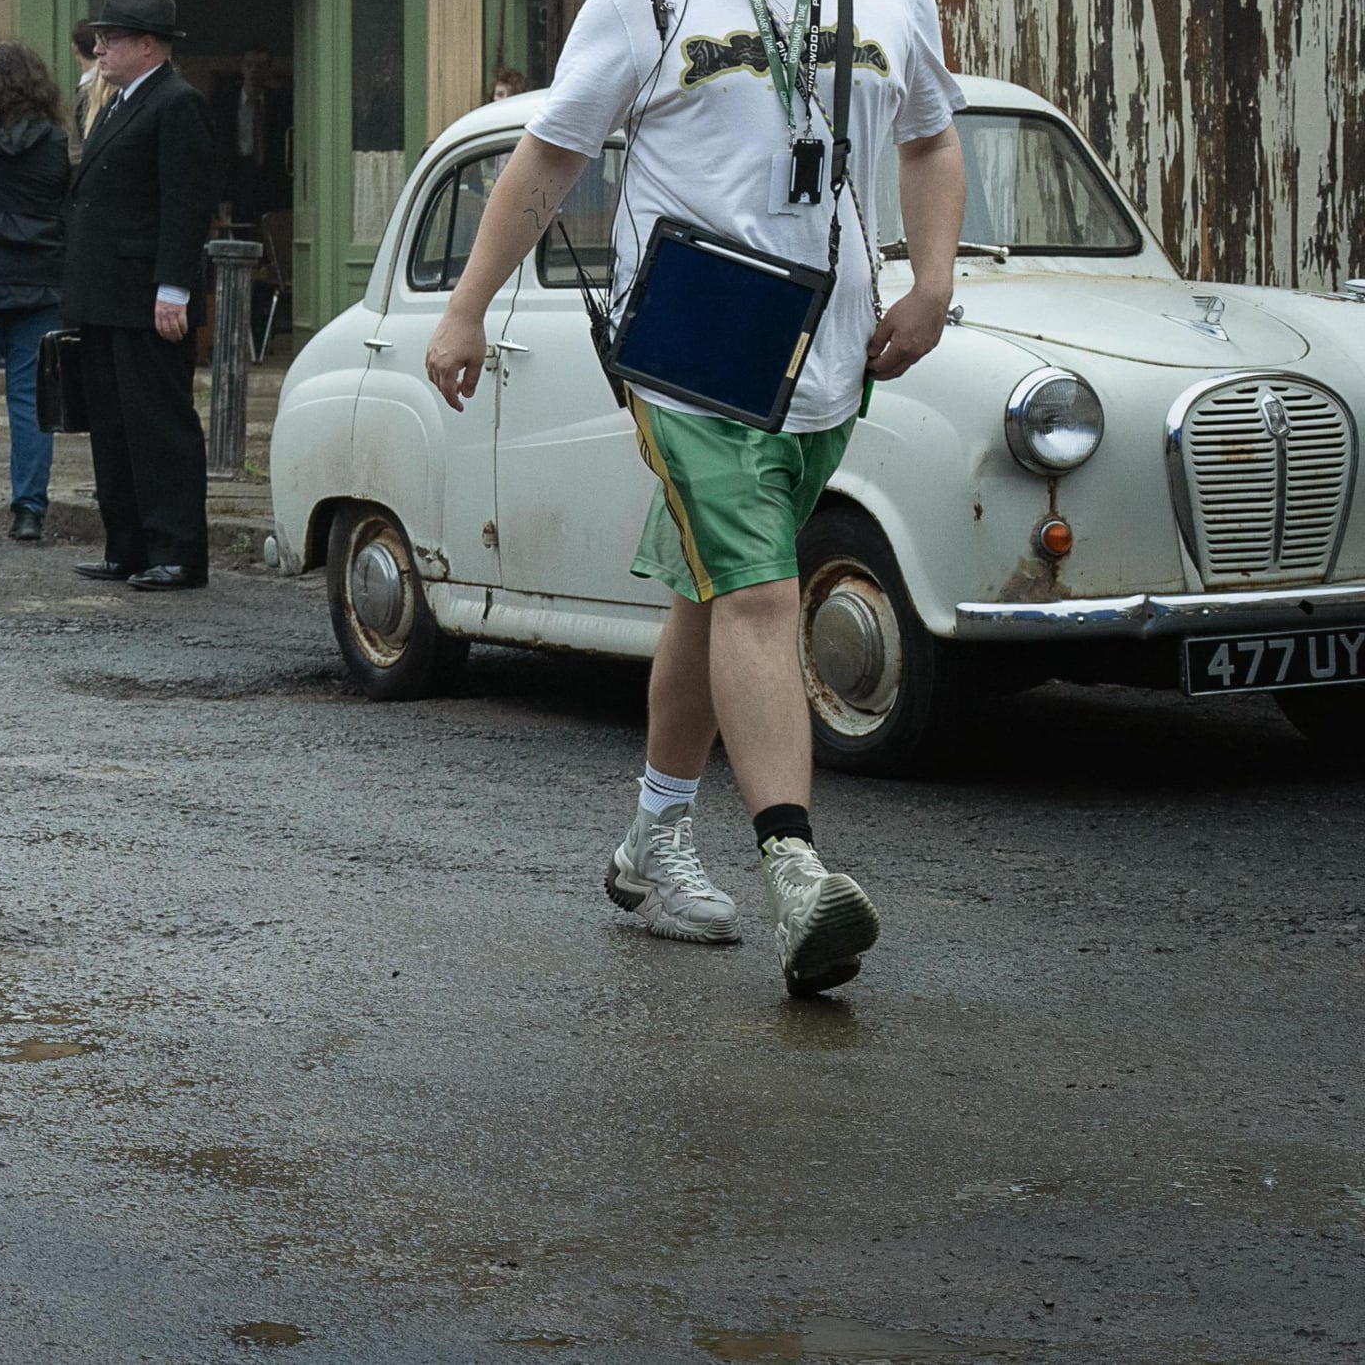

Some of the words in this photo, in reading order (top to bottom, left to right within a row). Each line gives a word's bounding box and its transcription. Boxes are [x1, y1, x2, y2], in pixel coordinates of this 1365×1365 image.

[763, 30, 776, 54] TIME
[789, 23, 805, 64] ORDINARY
[797, 3, 808, 27] TIME
[1207, 638, 1296, 686] 477
[1308, 632, 1365, 679] UY
